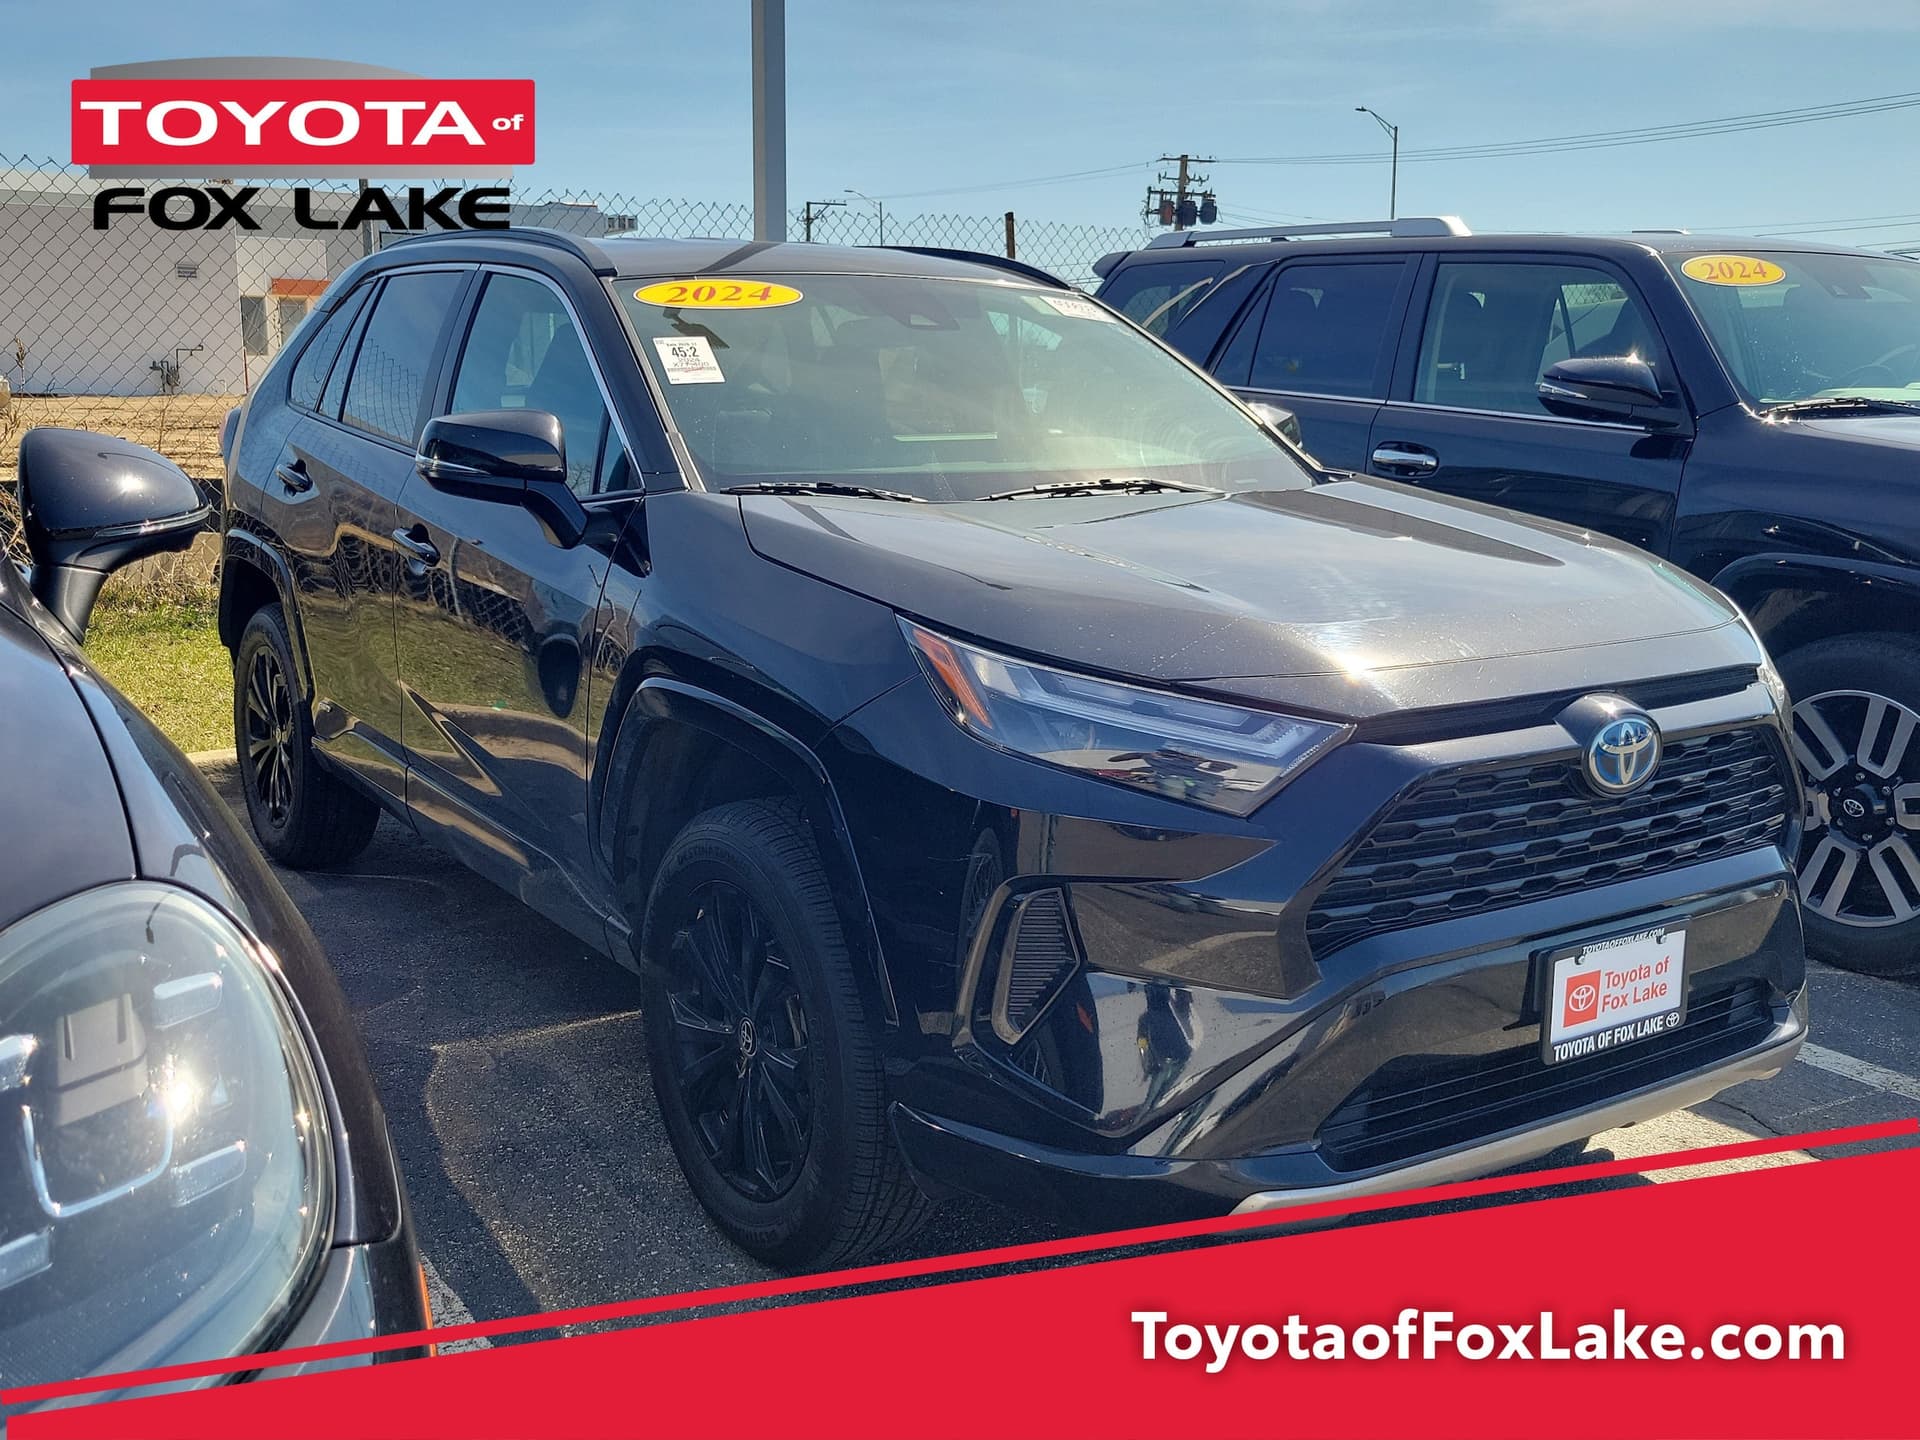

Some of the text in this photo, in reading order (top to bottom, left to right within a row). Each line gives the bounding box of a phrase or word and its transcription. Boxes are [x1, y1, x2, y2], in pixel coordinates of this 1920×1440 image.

[1701, 261, 1767, 280] 2024
[664, 285, 773, 303] 2024
[1582, 927, 1665, 955] TOYOTAOFFOXLAKE.COM
[1605, 956, 1670, 990] Toyota of
[1601, 981, 1668, 1013] Fox Lake
[1553, 1015, 1664, 1062] TOYOTA OF FOX LAKE
